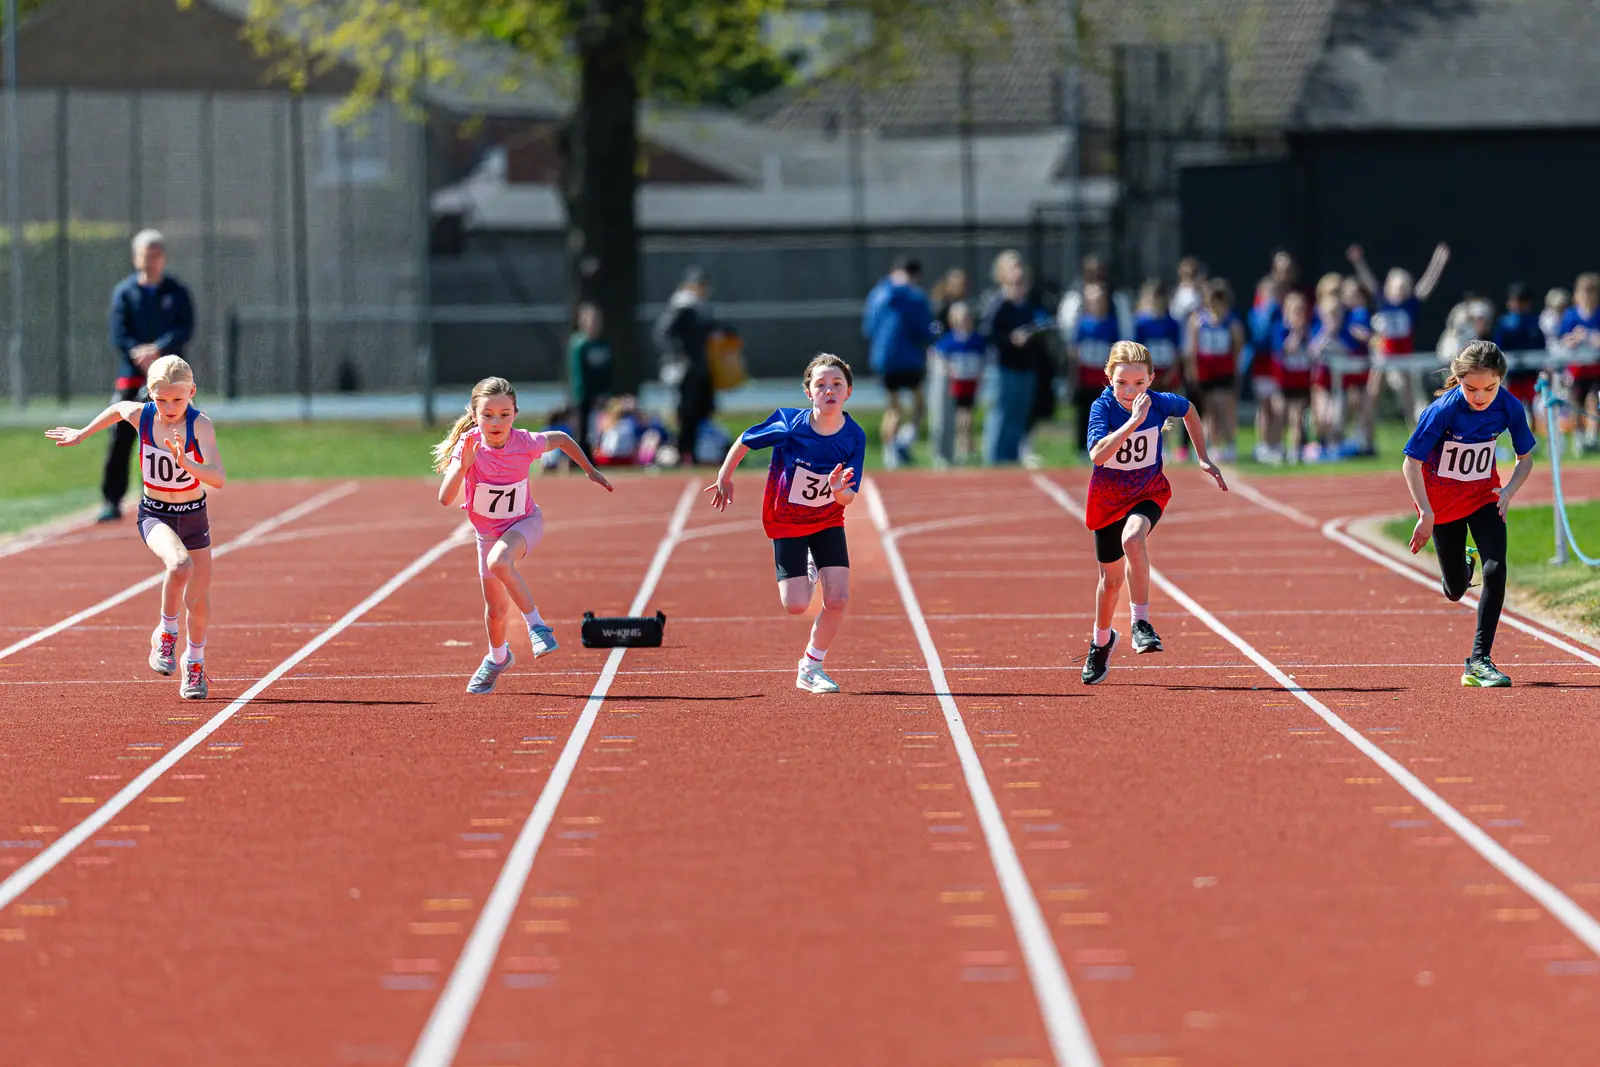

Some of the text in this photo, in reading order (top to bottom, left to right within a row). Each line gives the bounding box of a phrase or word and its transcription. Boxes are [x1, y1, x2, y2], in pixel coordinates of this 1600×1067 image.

[1116, 435, 1148, 464] 89
[1446, 446, 1491, 475] 100
[488, 487, 517, 513] 71
[801, 475, 832, 500] 34
[167, 502, 200, 512] NIKE
[602, 628, 642, 640] W-KING
